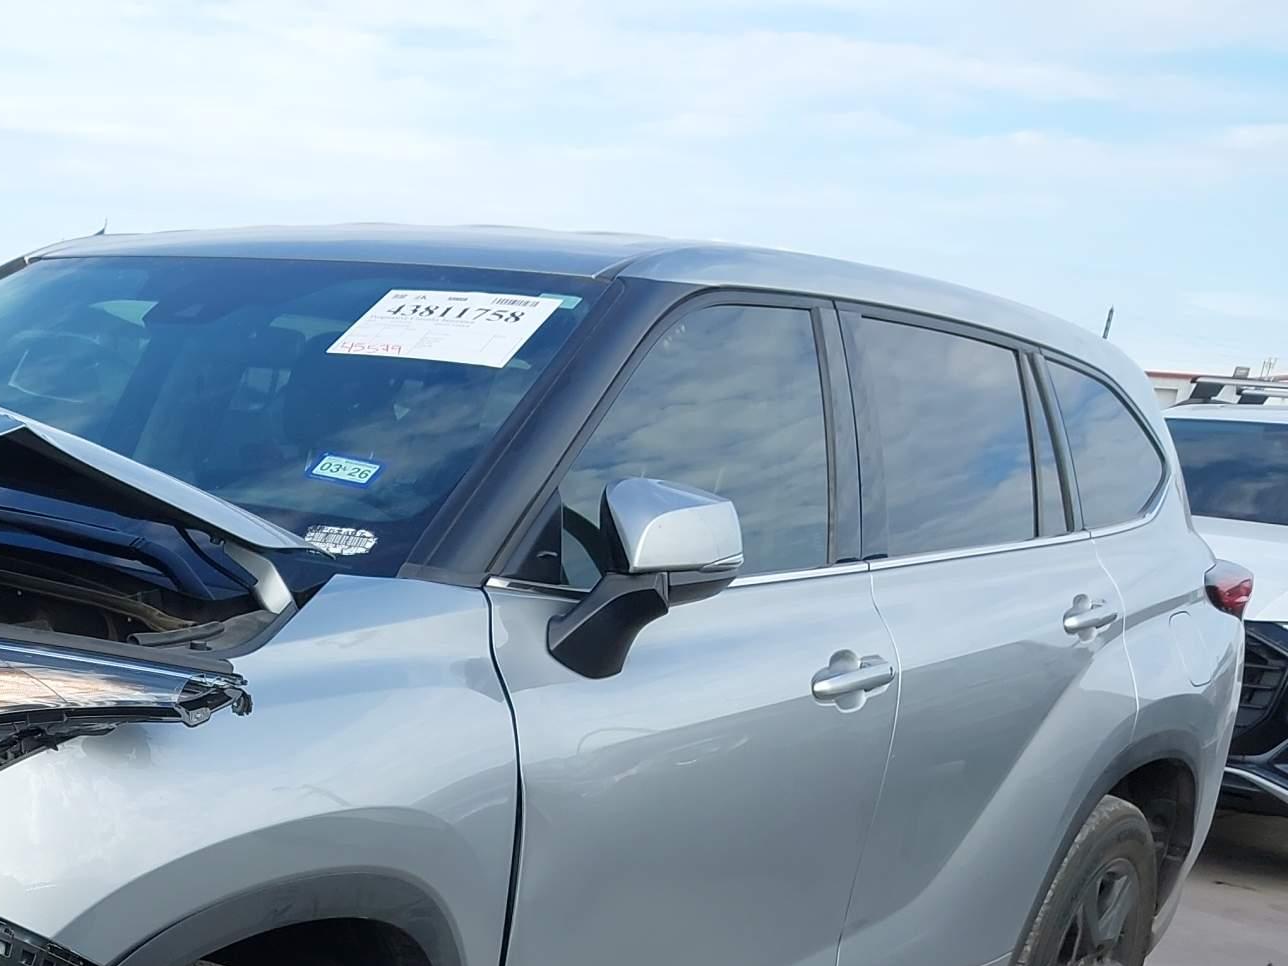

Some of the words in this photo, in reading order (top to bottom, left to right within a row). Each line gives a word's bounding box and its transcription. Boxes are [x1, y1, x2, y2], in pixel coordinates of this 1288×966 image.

[386, 302, 525, 324] 43811758
[319, 461, 342, 474] 03
[347, 467, 372, 480] 26
